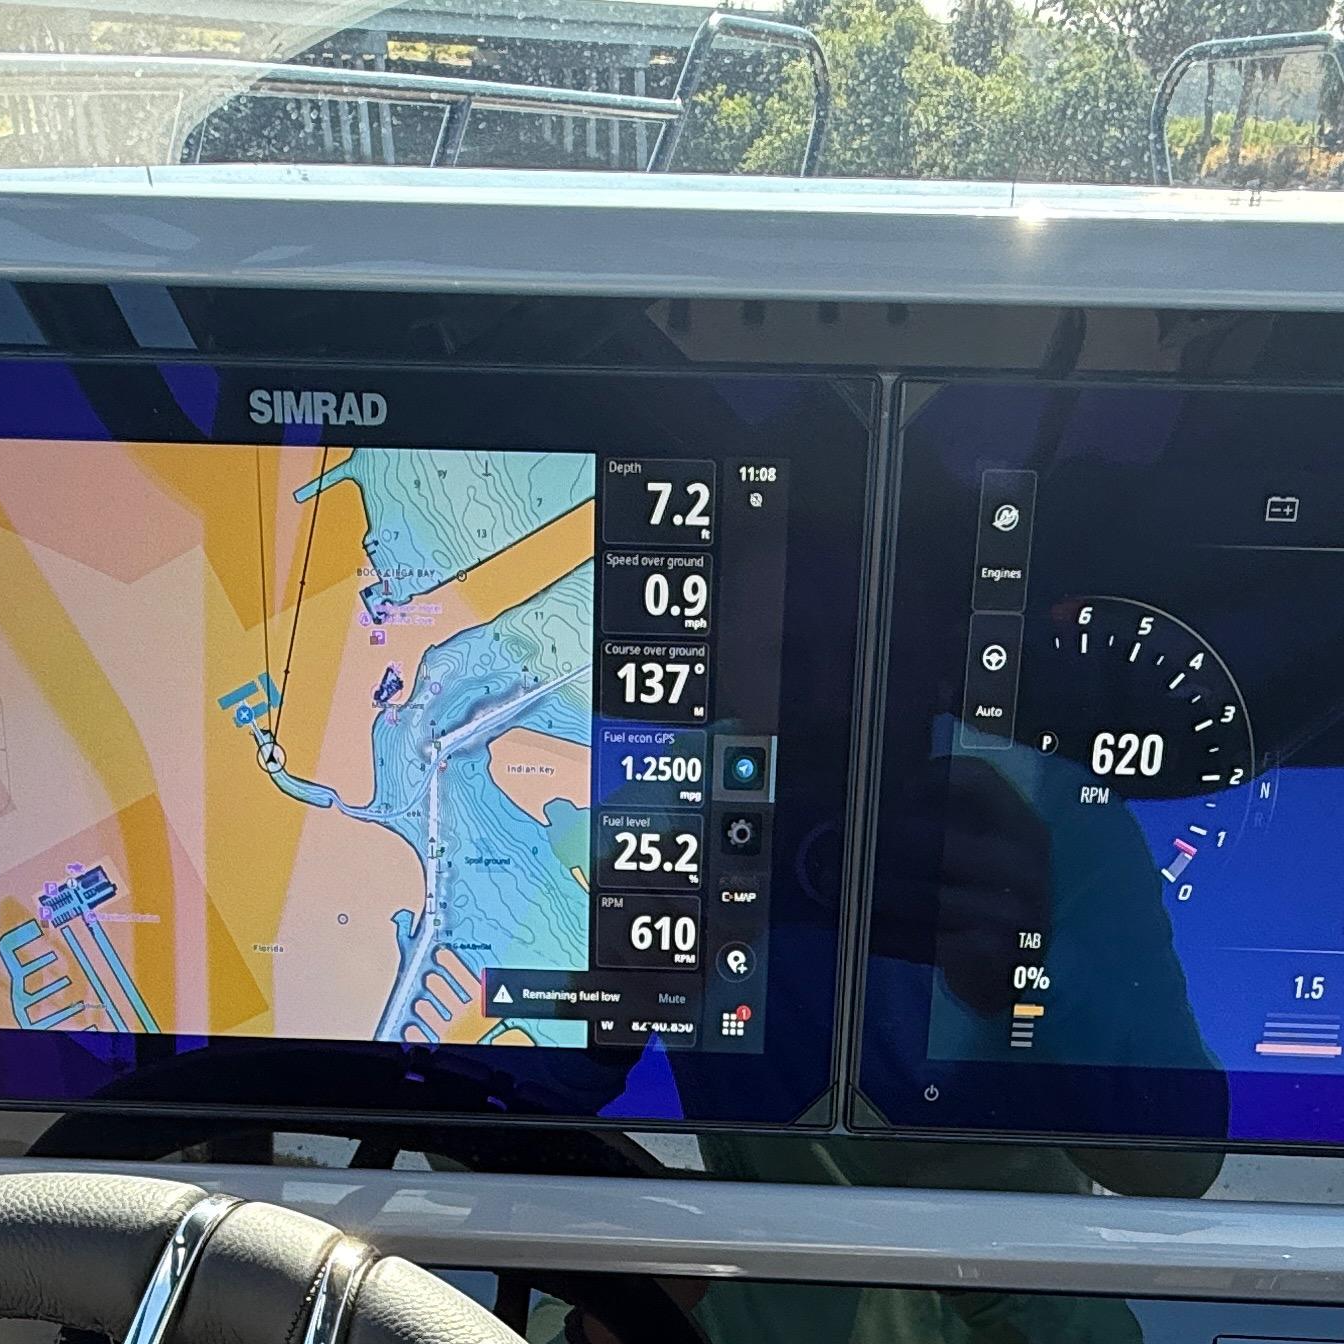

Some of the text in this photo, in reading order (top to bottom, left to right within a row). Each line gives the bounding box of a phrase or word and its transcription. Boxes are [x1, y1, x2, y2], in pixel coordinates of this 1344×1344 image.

[249, 390, 387, 425] SIMRAD
[609, 461, 641, 475] Depth
[739, 466, 776, 482] 11:08
[647, 482, 710, 527] 7.2
[701, 528, 710, 540] ft
[606, 553, 704, 570] Speed over ground
[981, 567, 1021, 581] Engines
[645, 574, 707, 616] 0.9
[1078, 606, 1093, 625] 6
[685, 618, 707, 630] mph
[1138, 617, 1154, 635] 5
[605, 643, 705, 659] Course over ground
[1189, 653, 1204, 671] 4
[976, 706, 1003, 718] Auto
[1221, 706, 1236, 723] 3
[604, 732, 675, 745] Fuel econ GPS
[1042, 735, 1052, 751] P
[1092, 733, 1164, 776] 620
[507, 765, 555, 776] Indian Key
[621, 756, 702, 782] 1.2500
[1229, 769, 1244, 785] 2
[680, 791, 701, 802] mpg
[1080, 787, 1109, 805] RPM
[1260, 783, 1270, 799] N
[603, 815, 650, 828] Fuel level
[1217, 831, 1226, 847] 1
[614, 832, 698, 872] 25.2
[1178, 885, 1192, 901] 0
[602, 897, 624, 909] RPM
[631, 916, 696, 952] 610
[1018, 932, 1042, 949] TAB
[674, 953, 695, 964] RPM
[1014, 966, 1050, 990] 0%
[522, 988, 621, 1004] Remaining fuel low
[1293, 976, 1325, 1000] 1.5
[659, 993, 686, 1004] Mute
